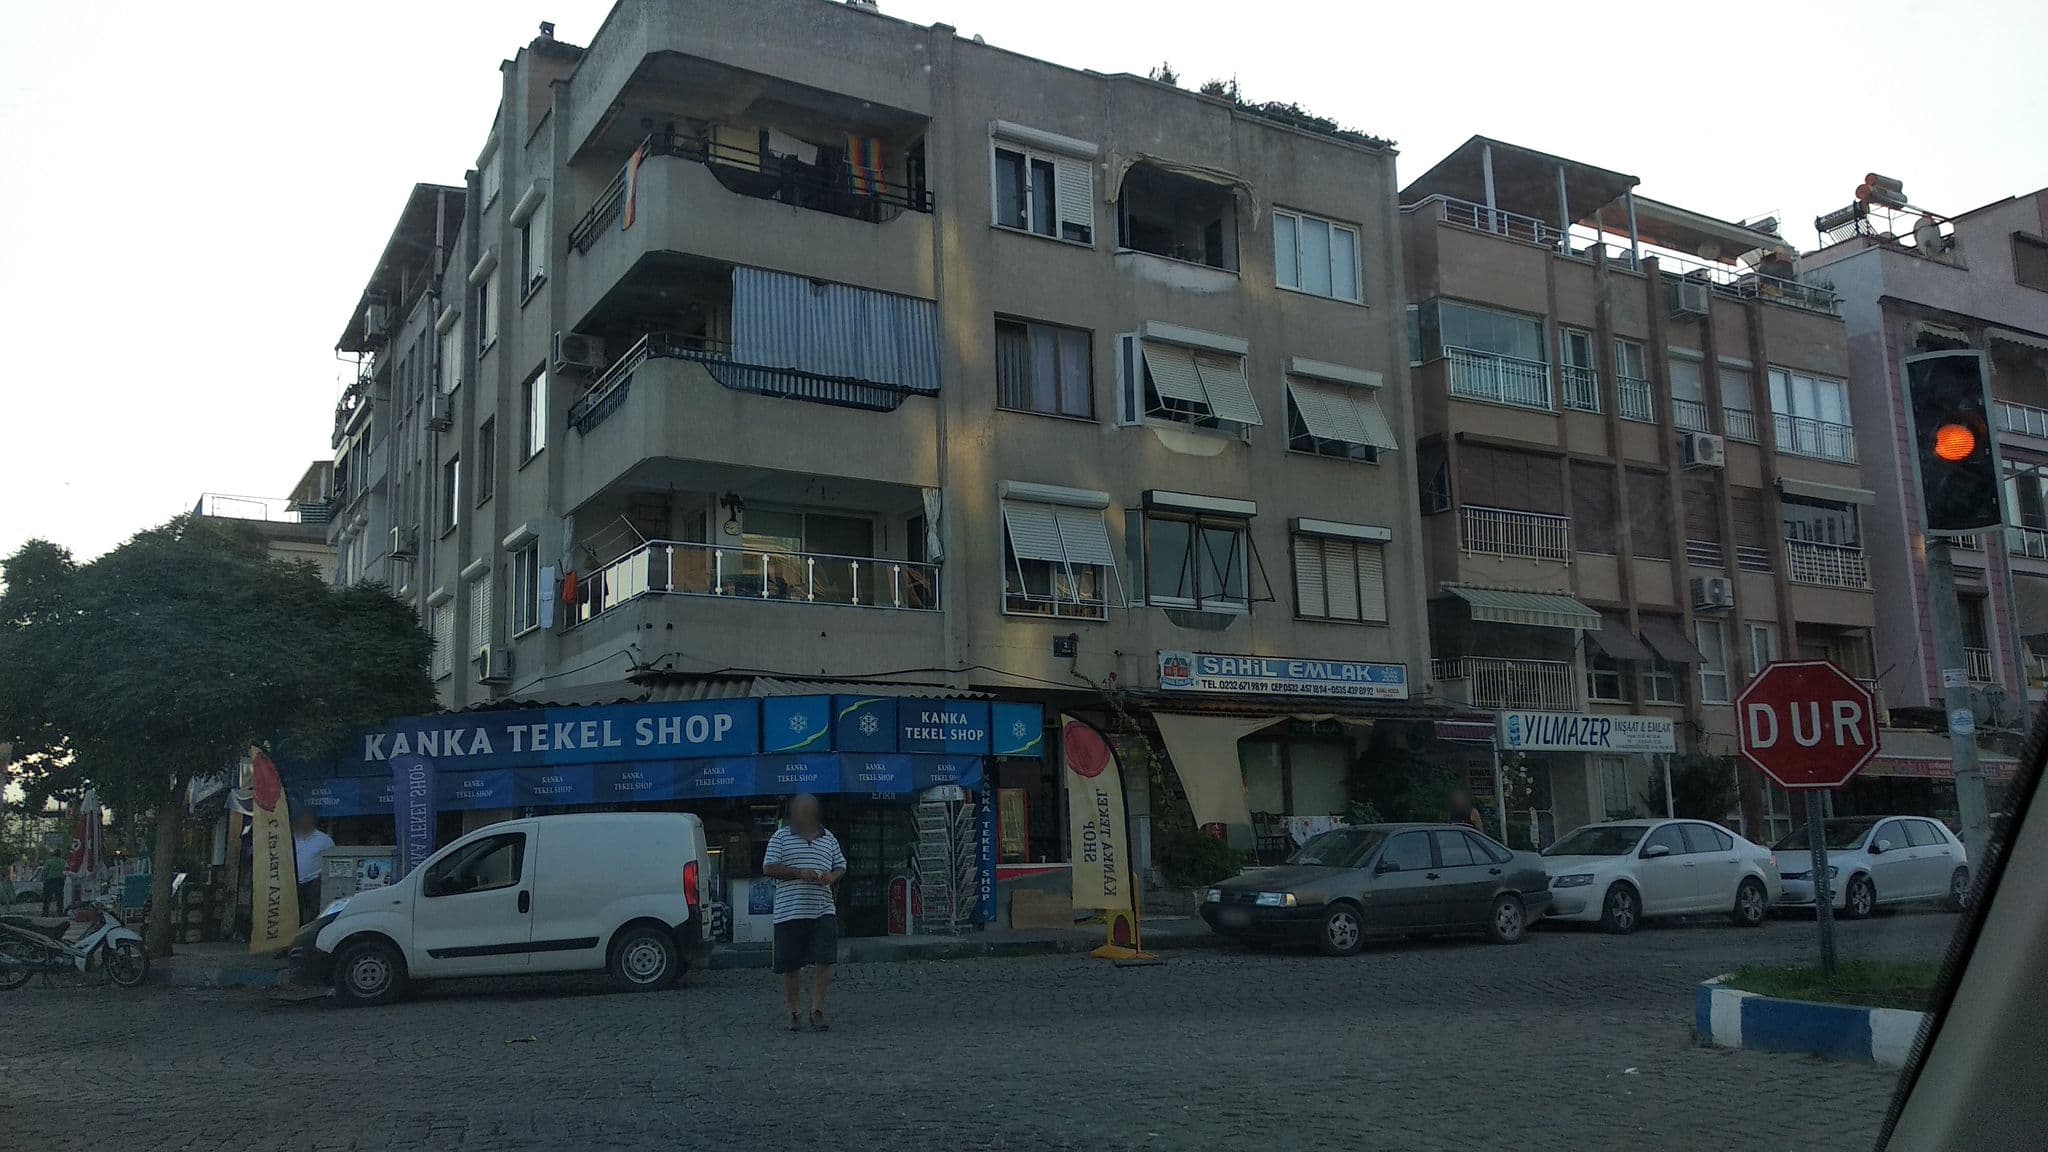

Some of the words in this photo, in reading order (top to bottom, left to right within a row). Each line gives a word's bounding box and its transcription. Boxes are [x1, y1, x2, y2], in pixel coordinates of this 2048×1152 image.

[1288, 662, 1373, 681] EMLAK
[921, 711, 968, 724] KANKA
[1748, 700, 1864, 750] DUR
[905, 726, 948, 740] TEKEL
[952, 728, 984, 742] SHOP
[1525, 715, 1611, 748] YILMAZER
[1648, 722, 1671, 732] EMLAK
[364, 727, 494, 761] KANKA
[508, 719, 622, 752] TEKEL
[636, 714, 734, 746] SHOP
[786, 764, 808, 772] KANKA
[865, 764, 886, 772] KANKA
[938, 764, 956, 772] KANKA
[542, 776, 563, 784] KANKA
[695, 778, 714, 786] TEKEL
[716, 777, 734, 785] SHOP
[778, 774, 798, 782] TEKEL
[799, 774, 818, 782] SHOP
[858, 774, 876, 782] TEKEL
[877, 774, 894, 782] SHOP
[930, 774, 948, 782] TEKEL
[464, 780, 484, 788] KANKA
[614, 782, 633, 790] TEKEL
[634, 782, 652, 790] SHOP
[456, 790, 476, 798] TEKEL
[476, 790, 494, 798] SHOP
[533, 786, 552, 794] TEKEL
[553, 785, 572, 793] SHOP
[981, 774, 992, 812] KANKA
[982, 821, 990, 861] TEKEL
[982, 870, 990, 901] SHOP
